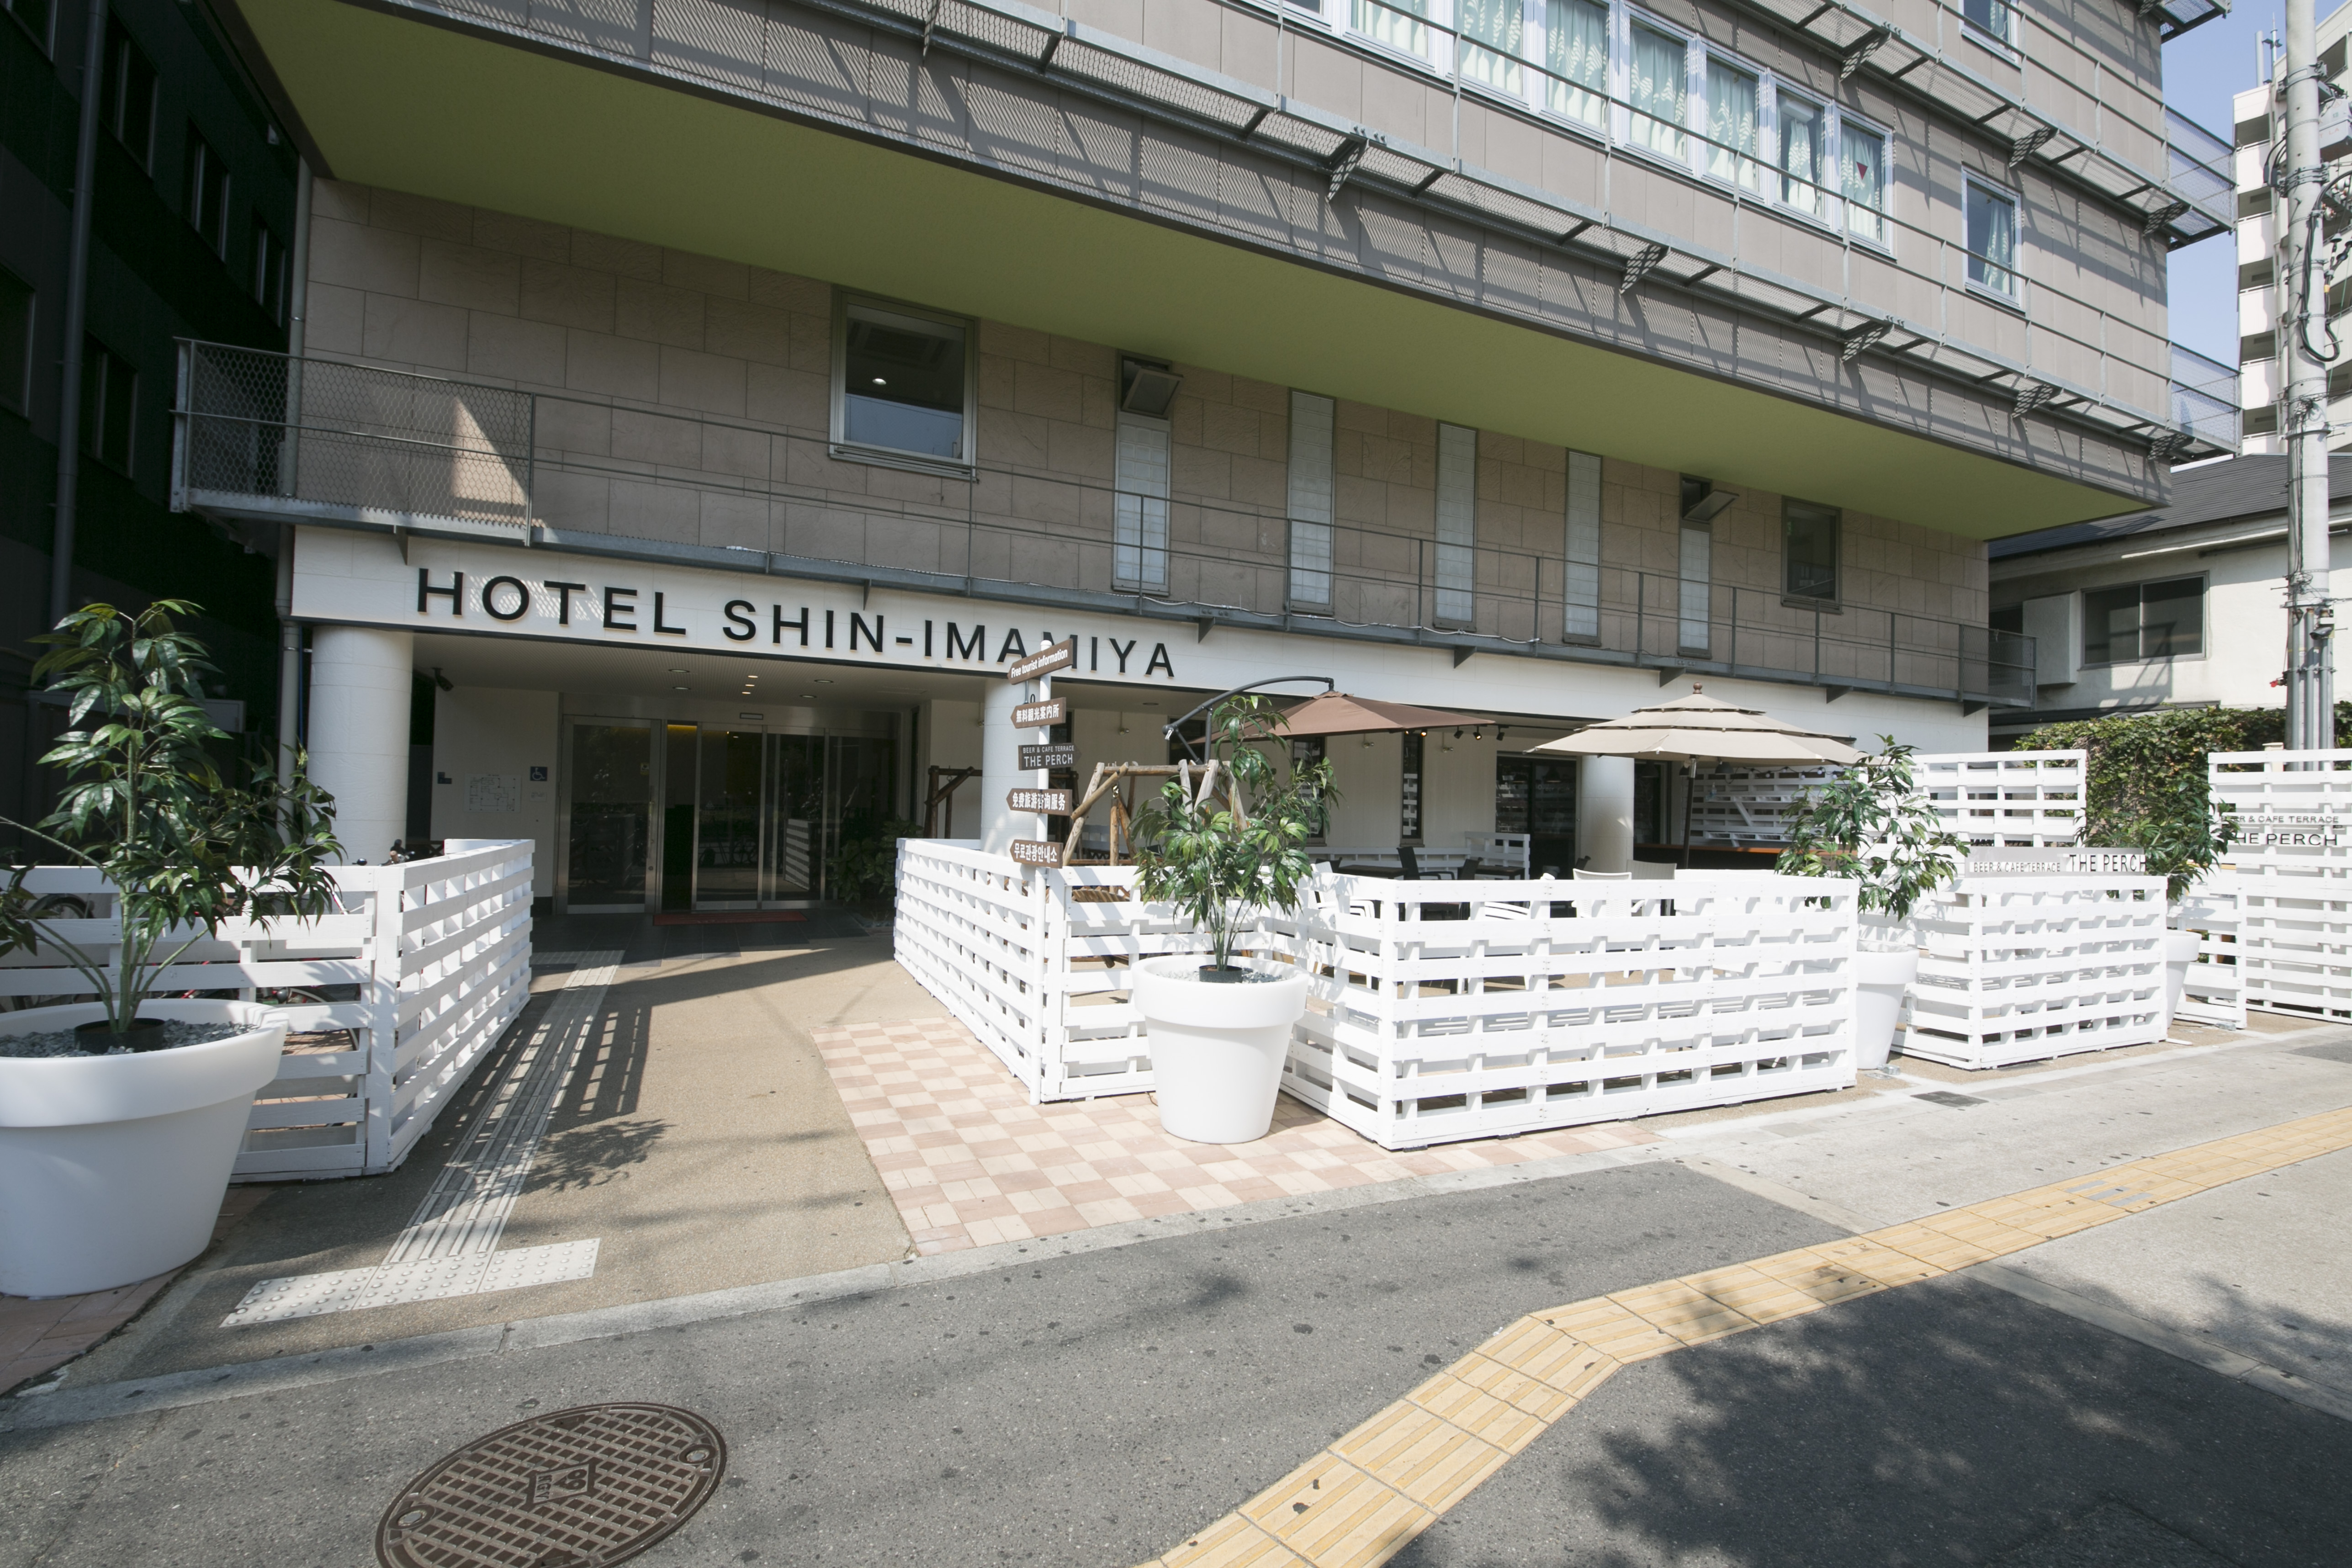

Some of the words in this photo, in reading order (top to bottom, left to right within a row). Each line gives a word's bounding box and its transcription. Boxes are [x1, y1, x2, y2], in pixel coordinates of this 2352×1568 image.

[418, 568, 686, 636] HOTEL
[1011, 667, 1021, 678] Free
[1022, 659, 1038, 674] tourist
[1038, 649, 1068, 668] information
[1016, 704, 1059, 723] 無料観光案内所
[1024, 756, 1041, 767] THE
[1045, 754, 1073, 766] PERCH
[1012, 792, 1065, 810] 免费旅游咨询服务
[2235, 833, 2259, 844] HE
[2266, 834, 2337, 846] PERCH
[1014, 842, 1057, 863] 무료관광안내소
[1974, 862, 1994, 872] BEER
[1997, 863, 2002, 872] &
[2005, 862, 2024, 872] CAFE
[2028, 862, 2061, 872] TERRACE
[2070, 854, 2096, 872] THE
[2103, 854, 2146, 872] PERCH
